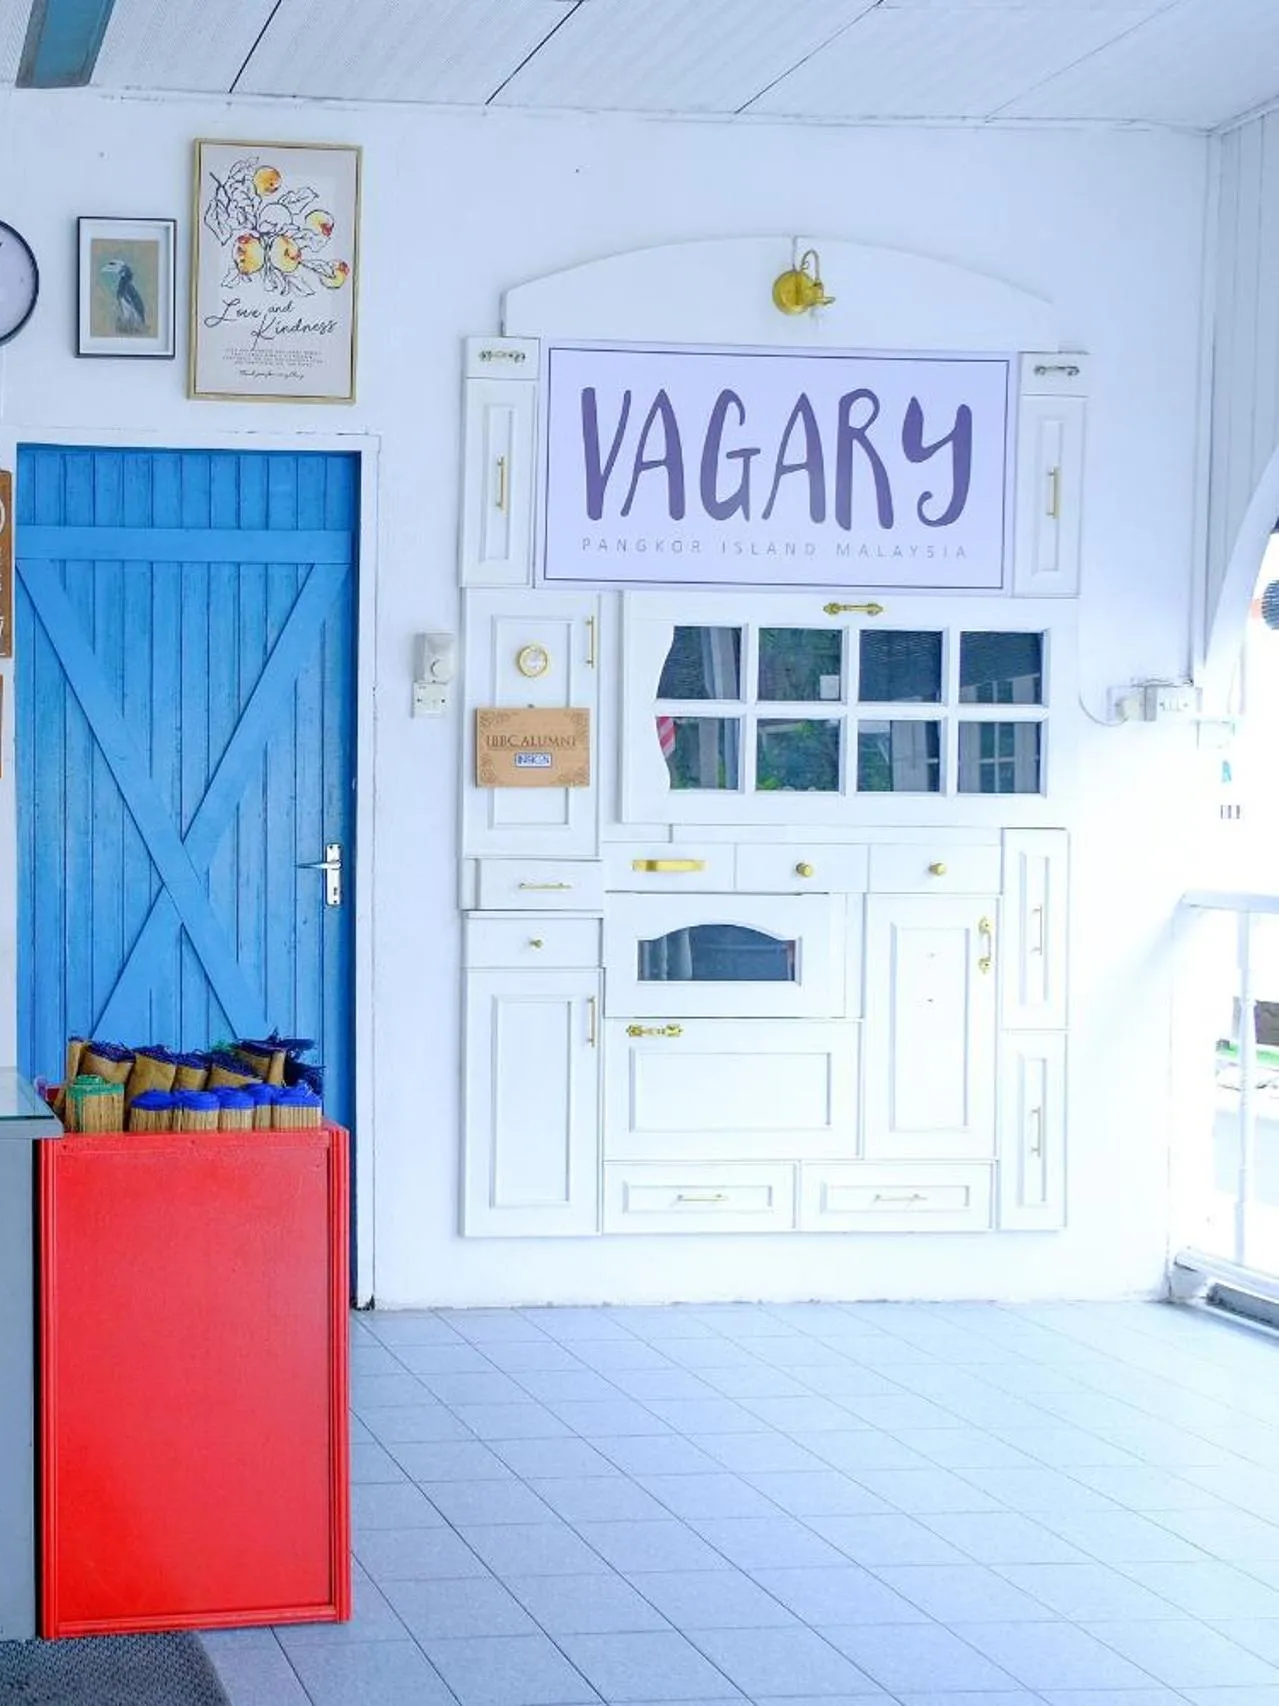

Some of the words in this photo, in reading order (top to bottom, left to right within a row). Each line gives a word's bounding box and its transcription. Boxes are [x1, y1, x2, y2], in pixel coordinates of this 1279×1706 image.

[204, 299, 261, 328] Love
[269, 301, 295, 314] and
[251, 309, 338, 350] Kindness
[581, 386, 972, 530] VAGARY
[583, 537, 702, 554] PANGKOR
[721, 541, 816, 557] ISLAND
[836, 543, 967, 560] MALAYSIA
[521, 735, 576, 748] ALUMNI
